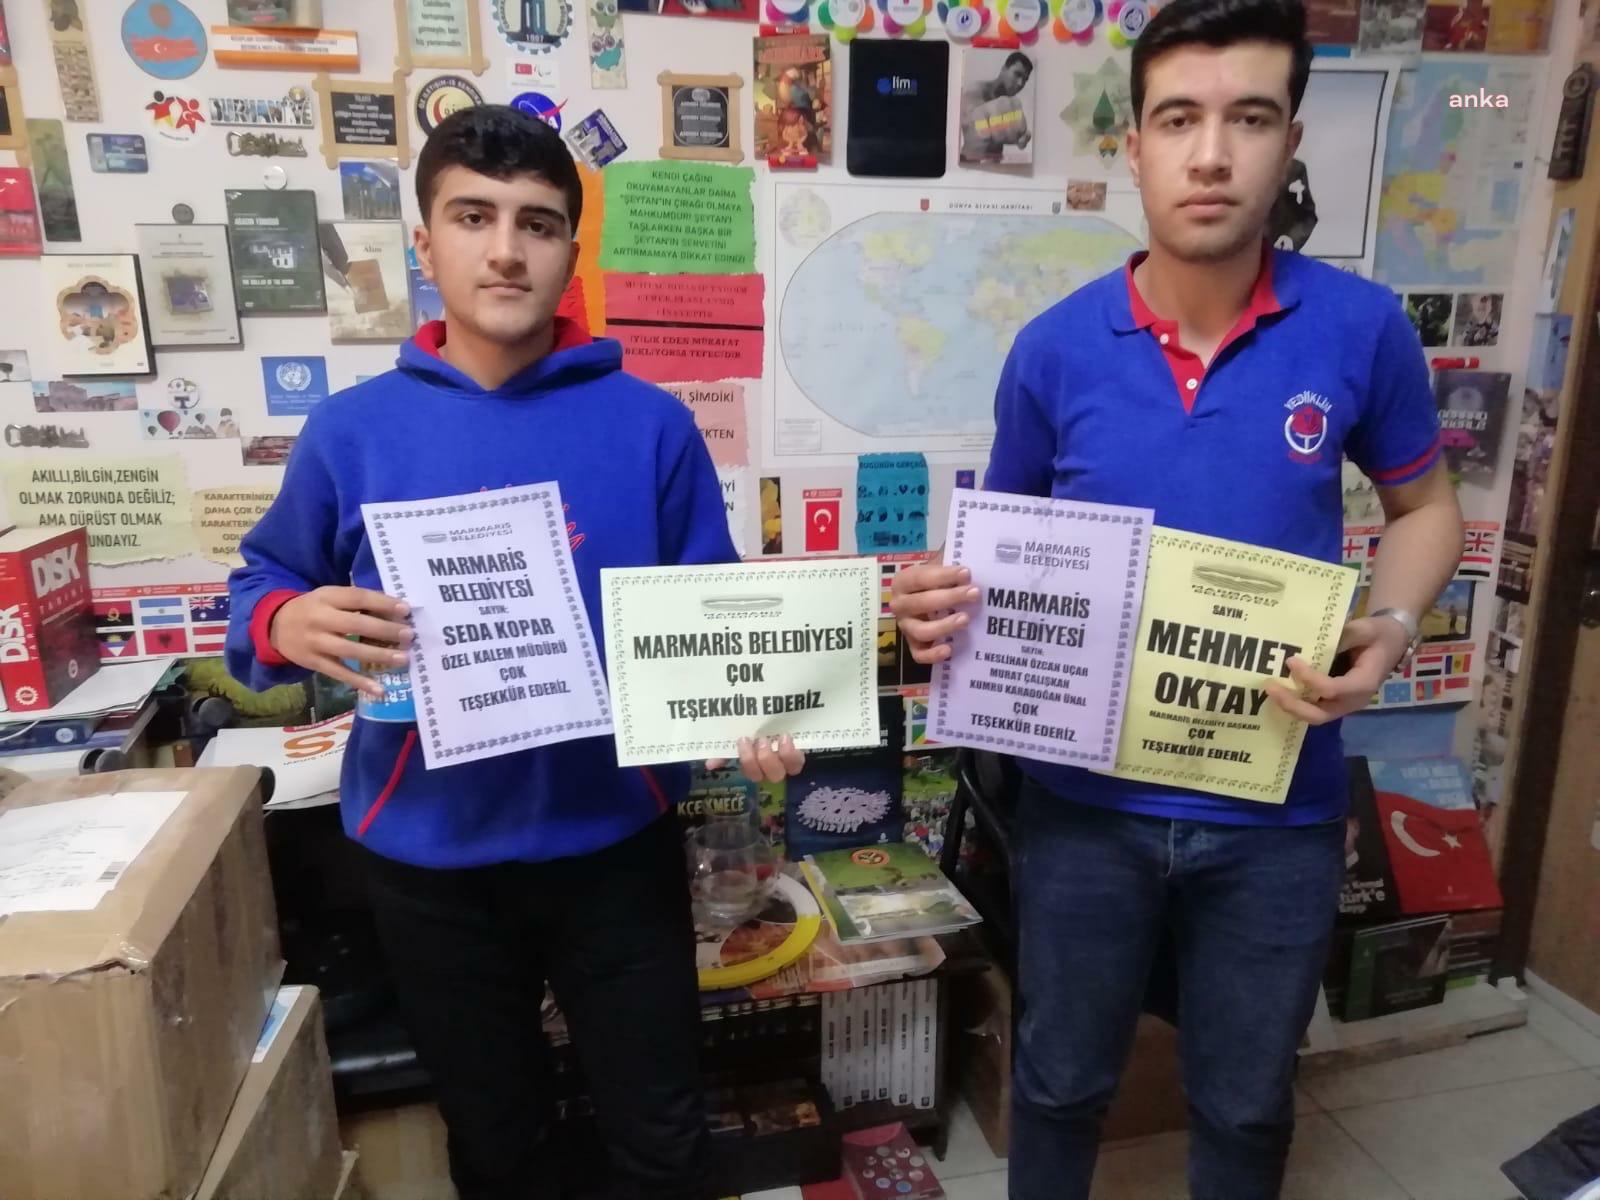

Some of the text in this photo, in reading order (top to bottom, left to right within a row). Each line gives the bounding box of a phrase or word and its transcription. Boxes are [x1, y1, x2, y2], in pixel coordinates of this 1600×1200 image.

[688, 388, 734, 403] ŞİMDİKİ
[19, 491, 64, 505] OLMAK
[67, 491, 125, 505] ZORUNDA
[204, 506, 232, 514] DAHA
[233, 506, 253, 516] ÇOK
[38, 510, 163, 527] AMA DÜRÜST OLMAK
[87, 534, 142, 548] UNDAYIZ.
[1024, 541, 1091, 558] MARMARİS
[427, 546, 528, 577] MARMARİS
[1023, 554, 1090, 571] BELEDİYESİ
[438, 574, 535, 603] BELEDİYESİ
[987, 587, 1091, 619] MARMARİS
[1212, 604, 1244, 619] SAYIN
[442, 617, 556, 646] SEDA KOPAR
[633, 621, 853, 660] MARMARİS BELEDİYESİ
[986, 615, 1086, 649] BELEDİYESİ
[441, 639, 568, 671] ÖZEL KALEM MÜDÜRÜ
[1147, 618, 1302, 678] MEHMET
[499, 665, 527, 683] ÇOK
[726, 662, 764, 687] ÇOK
[975, 650, 1089, 677] E. NESLİHAN ÖZCAN UÇAR
[989, 667, 1070, 689] MURAT ÇALIŞKAN
[459, 680, 572, 712] TEŞEKKÜR EDERİZ.
[667, 689, 825, 722] TEŞEKKÜR EDERİZ.
[969, 679, 1088, 707] KUMRU KARADOĞAN ÜNAL
[1154, 671, 1270, 716] OKTAY
[1012, 701, 1039, 717] ÇOK
[970, 713, 1078, 743] TEŞEKKÜR EDERİZ.
[1188, 727, 1216, 741] ÇOK
[1142, 738, 1253, 764] TEŞEKKÜR EDERİZ.
